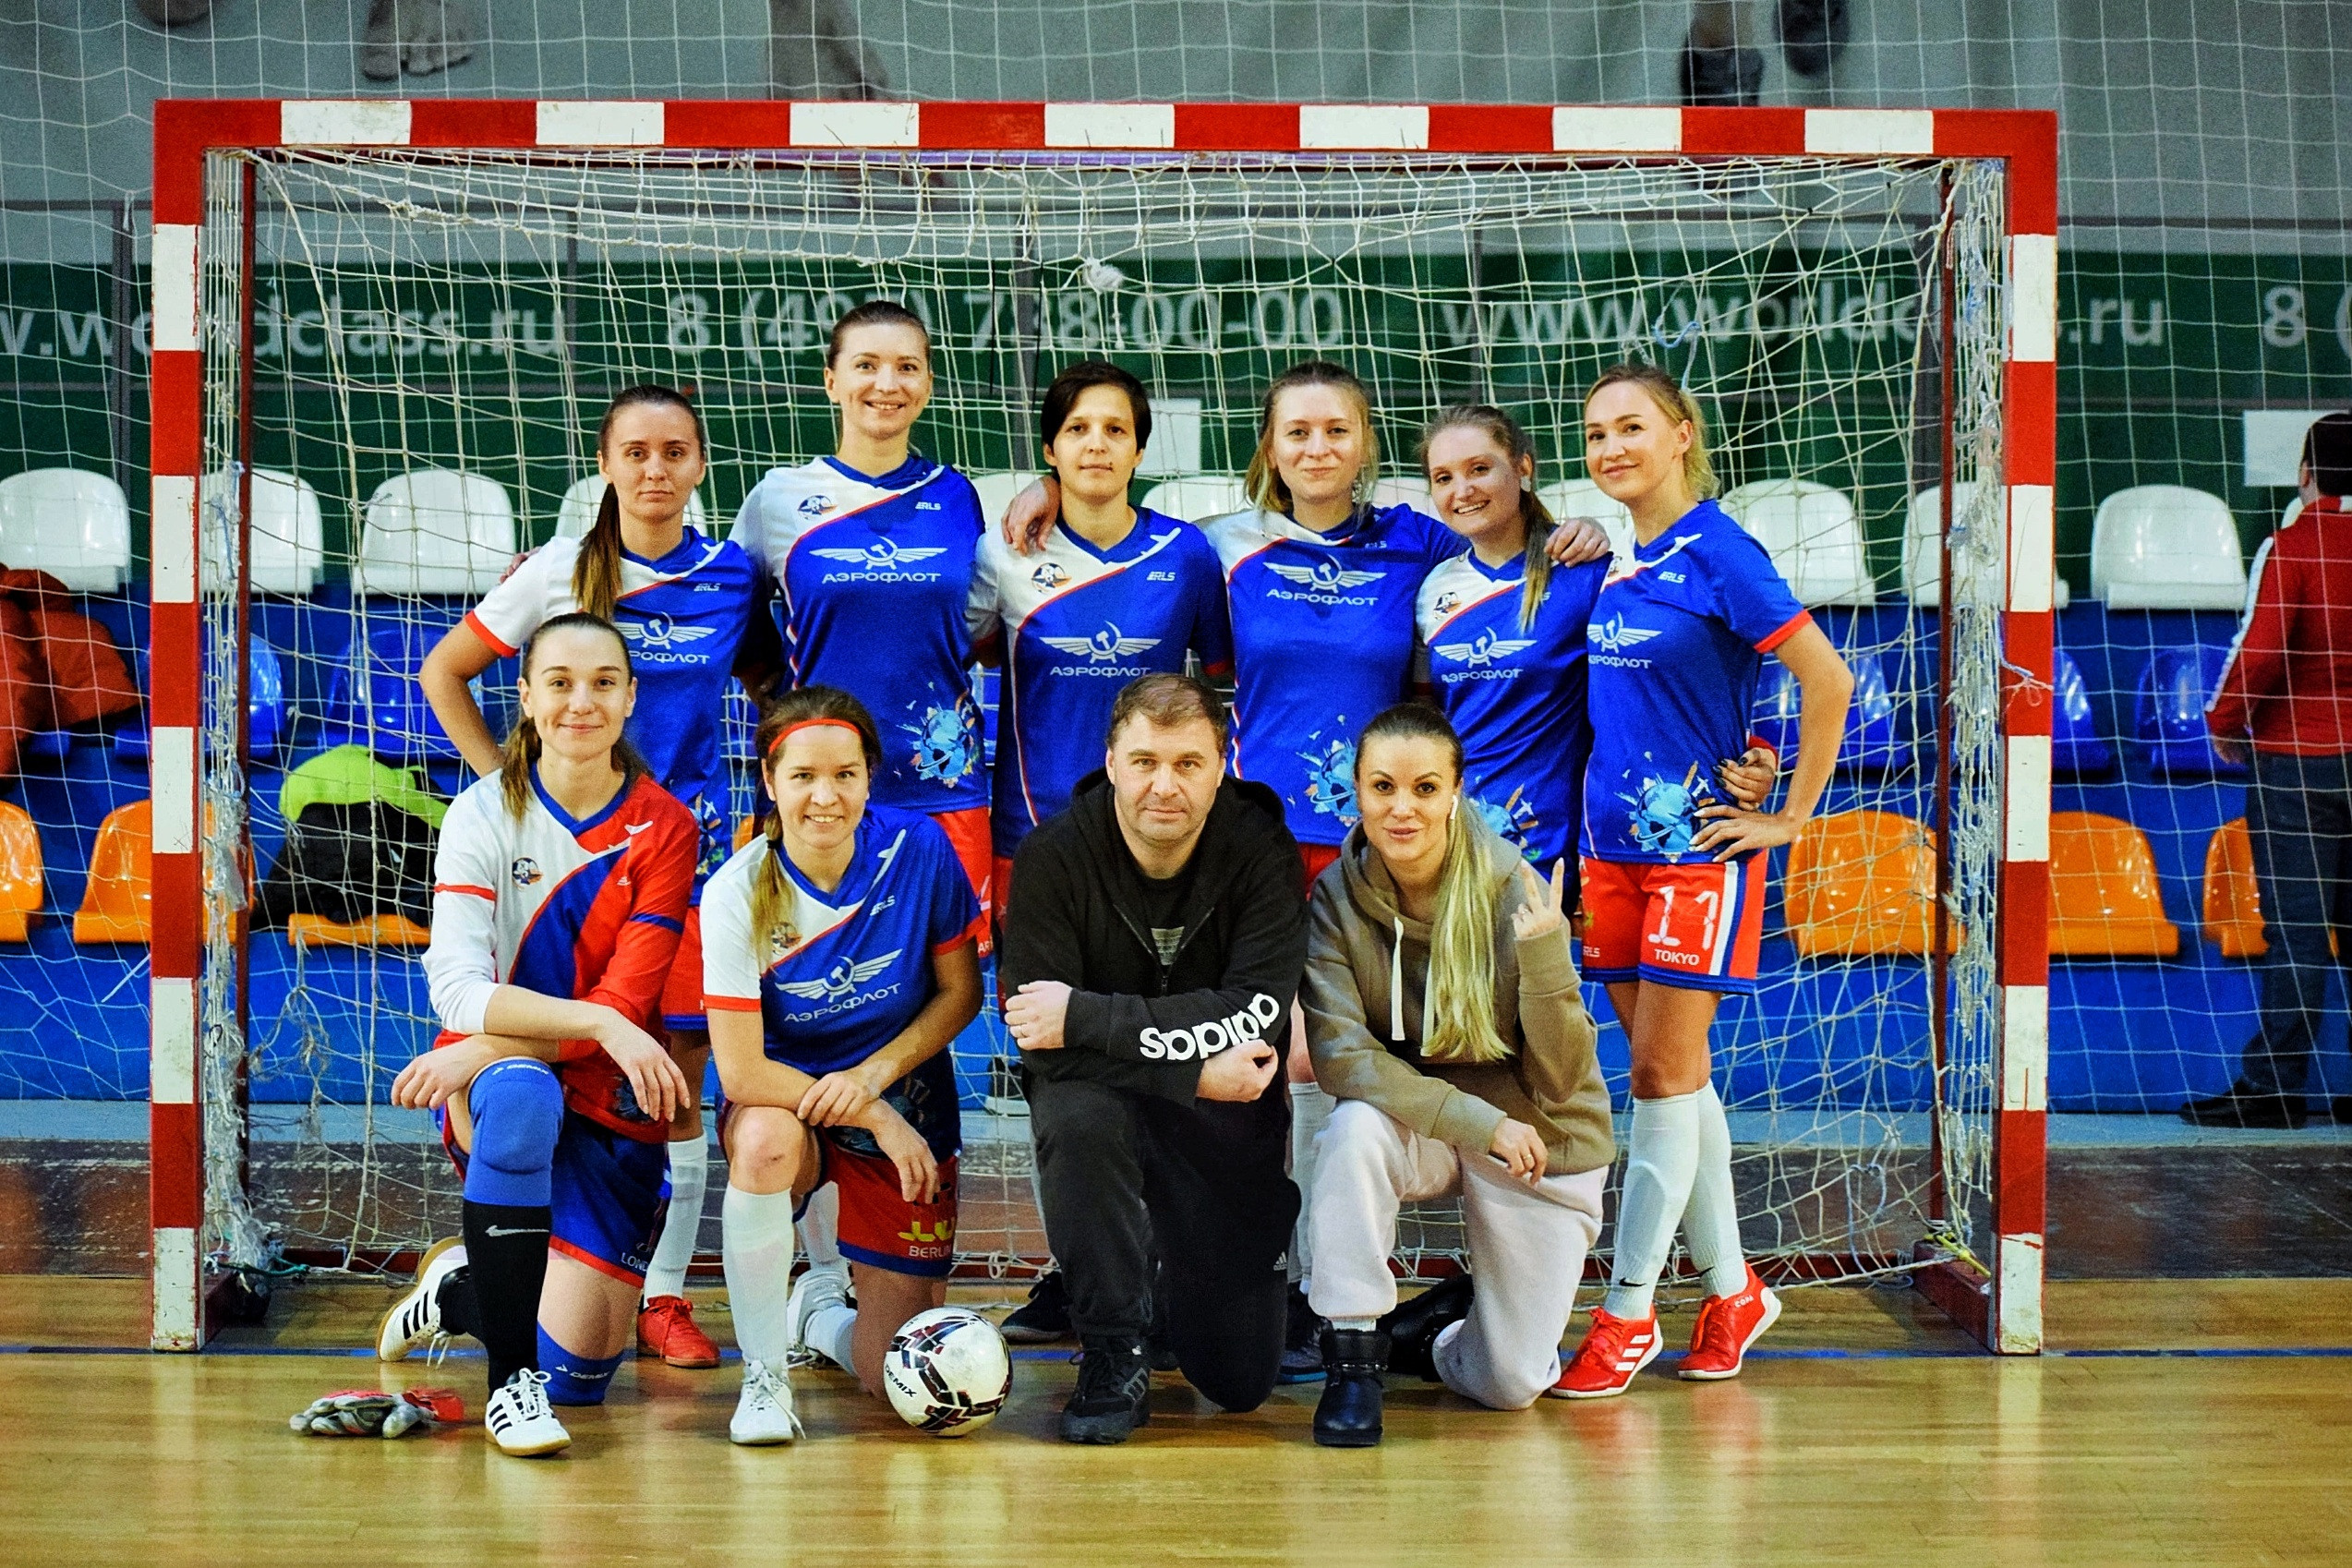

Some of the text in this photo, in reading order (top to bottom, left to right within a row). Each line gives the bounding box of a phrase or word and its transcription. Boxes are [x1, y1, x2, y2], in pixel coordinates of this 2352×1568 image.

[667, 292, 711, 355] 8
[2262, 285, 2307, 347] 8
[821, 572, 942, 585] АЭРОФЛОТ
[1266, 588, 1379, 606] АЭРОФЛОТ
[628, 650, 711, 665] РОФЛОТ
[1050, 666, 1151, 678] АЭРОФЛОТ
[1441, 668, 1524, 683] АЭРОФЛОТ
[1654, 948, 1700, 966] TOKYO
[784, 983, 901, 1022] АЭРОФЛОТ
[884, 1362, 918, 1398] DEMIX
